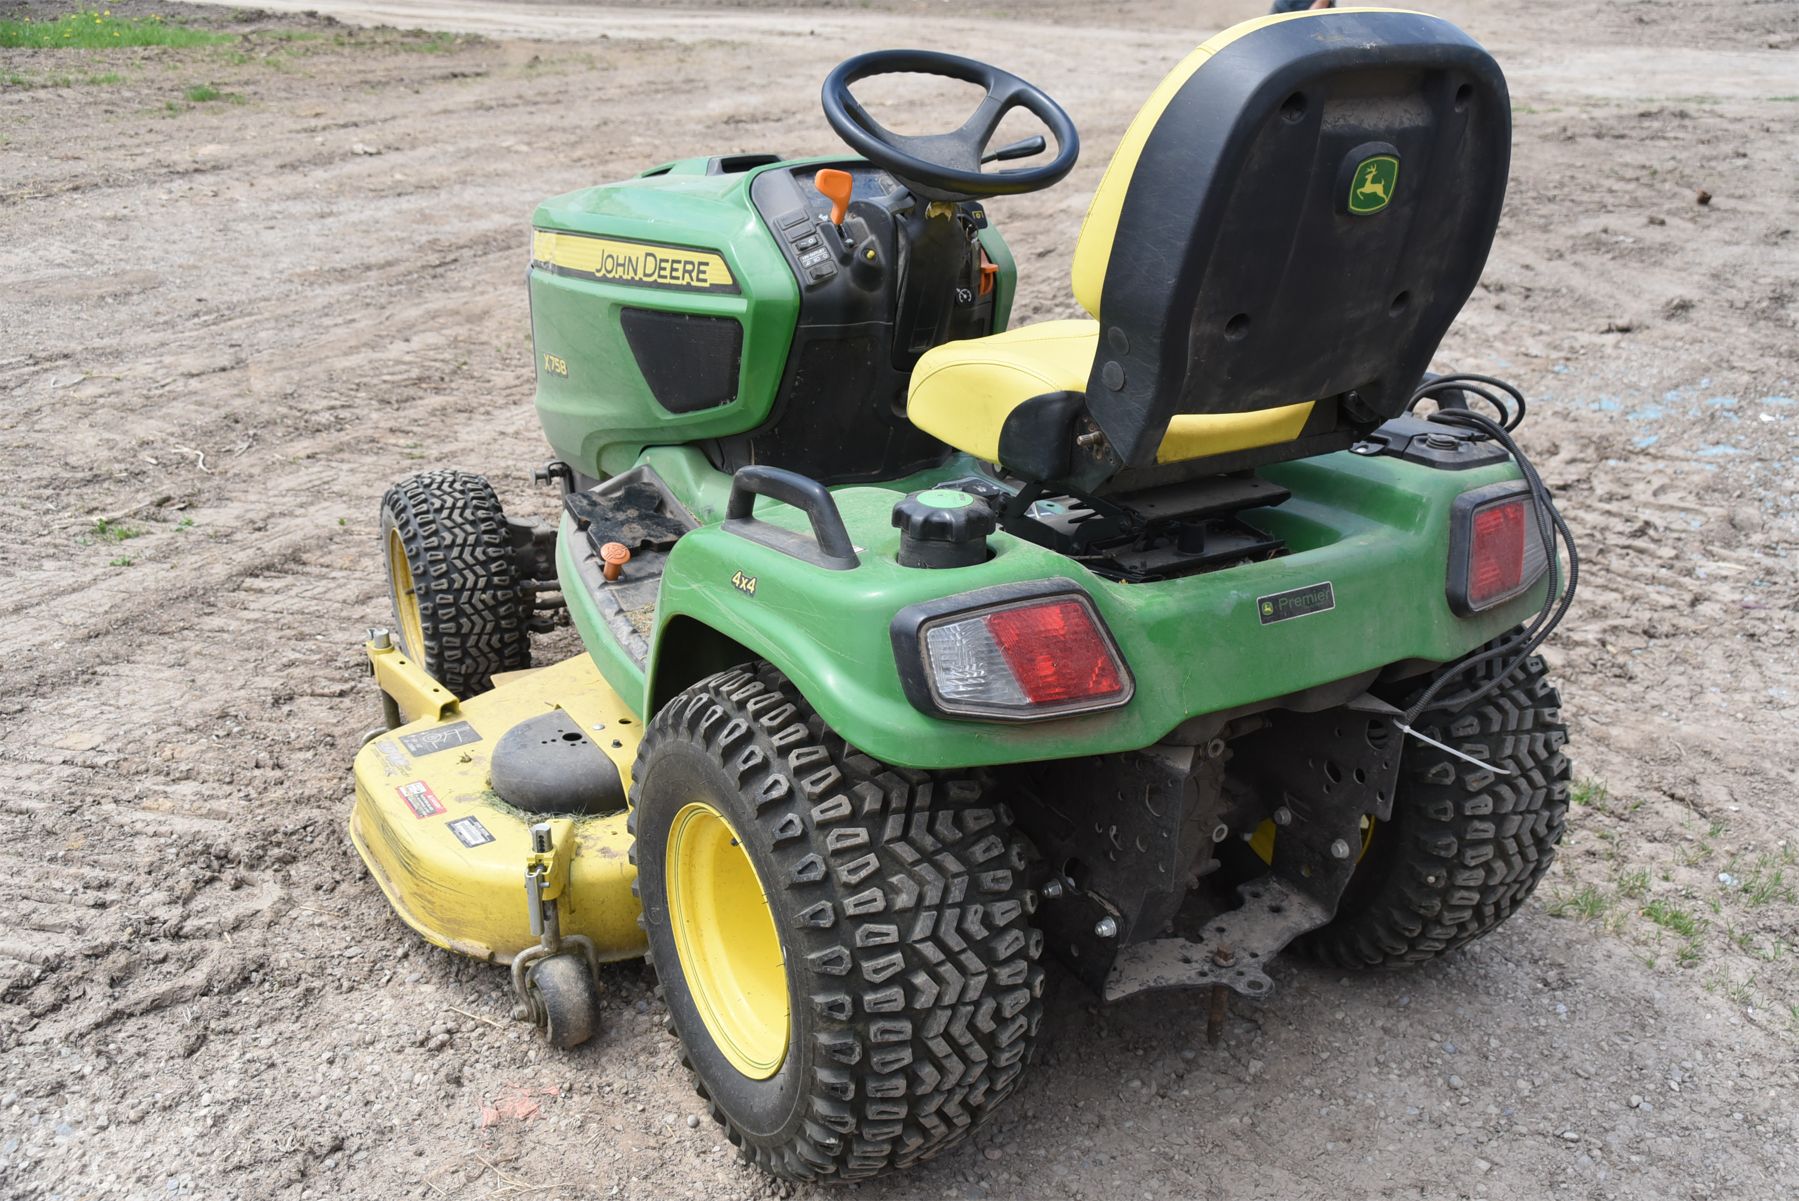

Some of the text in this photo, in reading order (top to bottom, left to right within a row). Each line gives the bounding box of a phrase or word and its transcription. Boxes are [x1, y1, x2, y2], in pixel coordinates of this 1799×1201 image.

[595, 249, 710, 284] JOHN DEERE
[543, 353, 568, 375] X758
[1278, 588, 1330, 611] Premier
